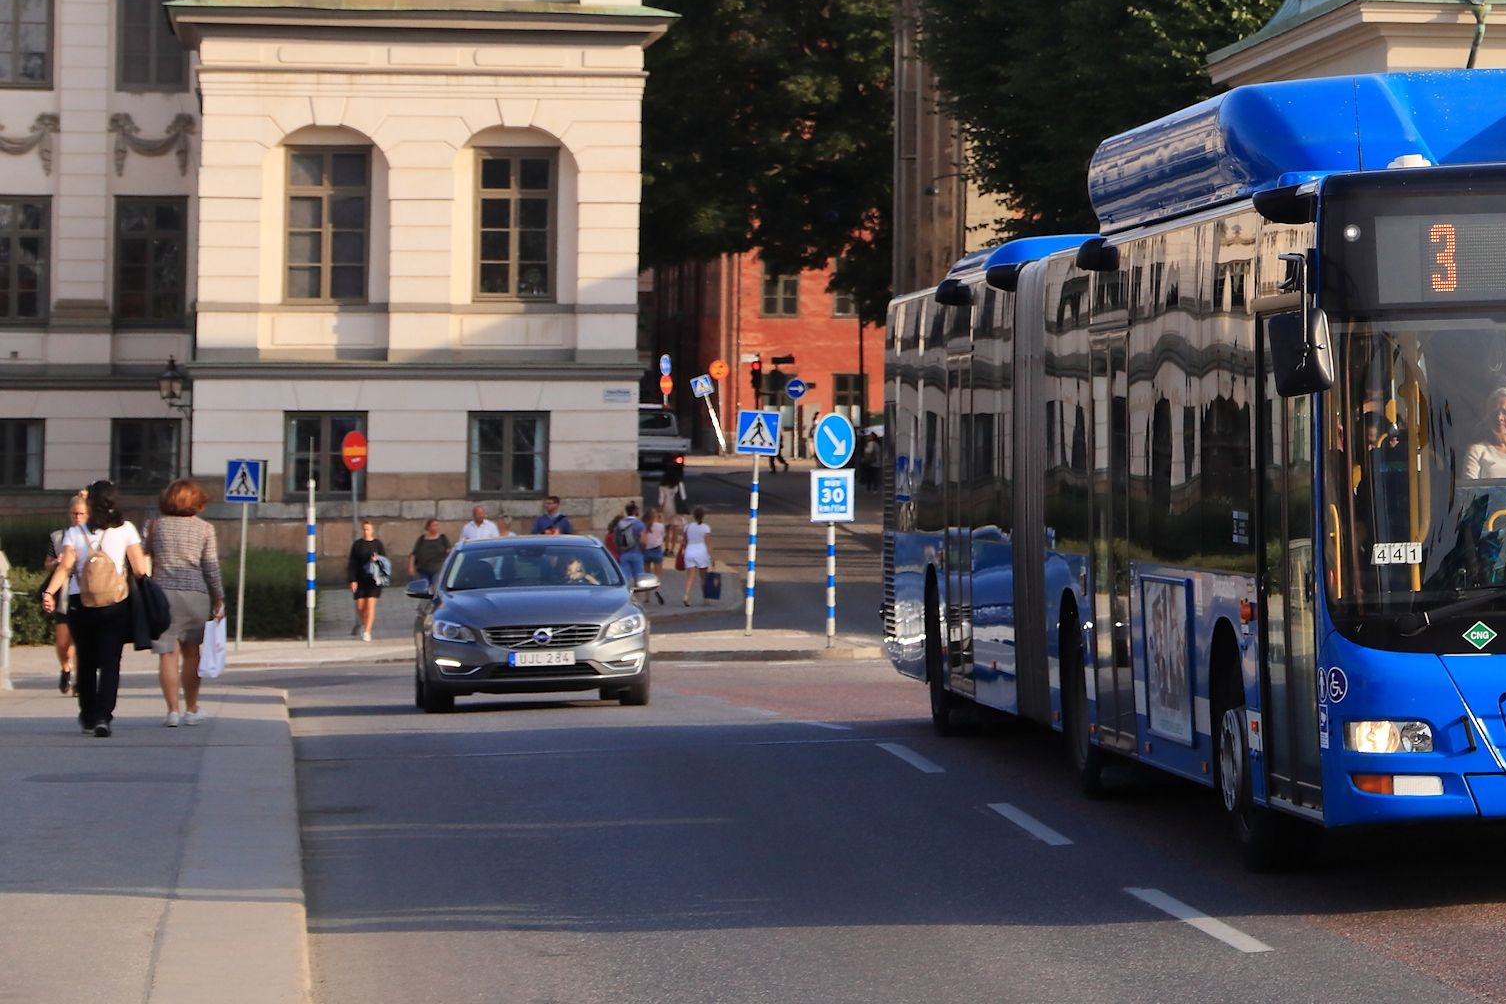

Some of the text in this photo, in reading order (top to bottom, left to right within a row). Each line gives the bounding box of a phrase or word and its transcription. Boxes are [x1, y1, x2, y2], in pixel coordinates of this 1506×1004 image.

[1430, 224, 1457, 292] 3
[821, 487, 845, 503] 30
[1377, 548, 1417, 562] 441
[1470, 631, 1490, 640] CNG
[519, 653, 543, 665] UJL
